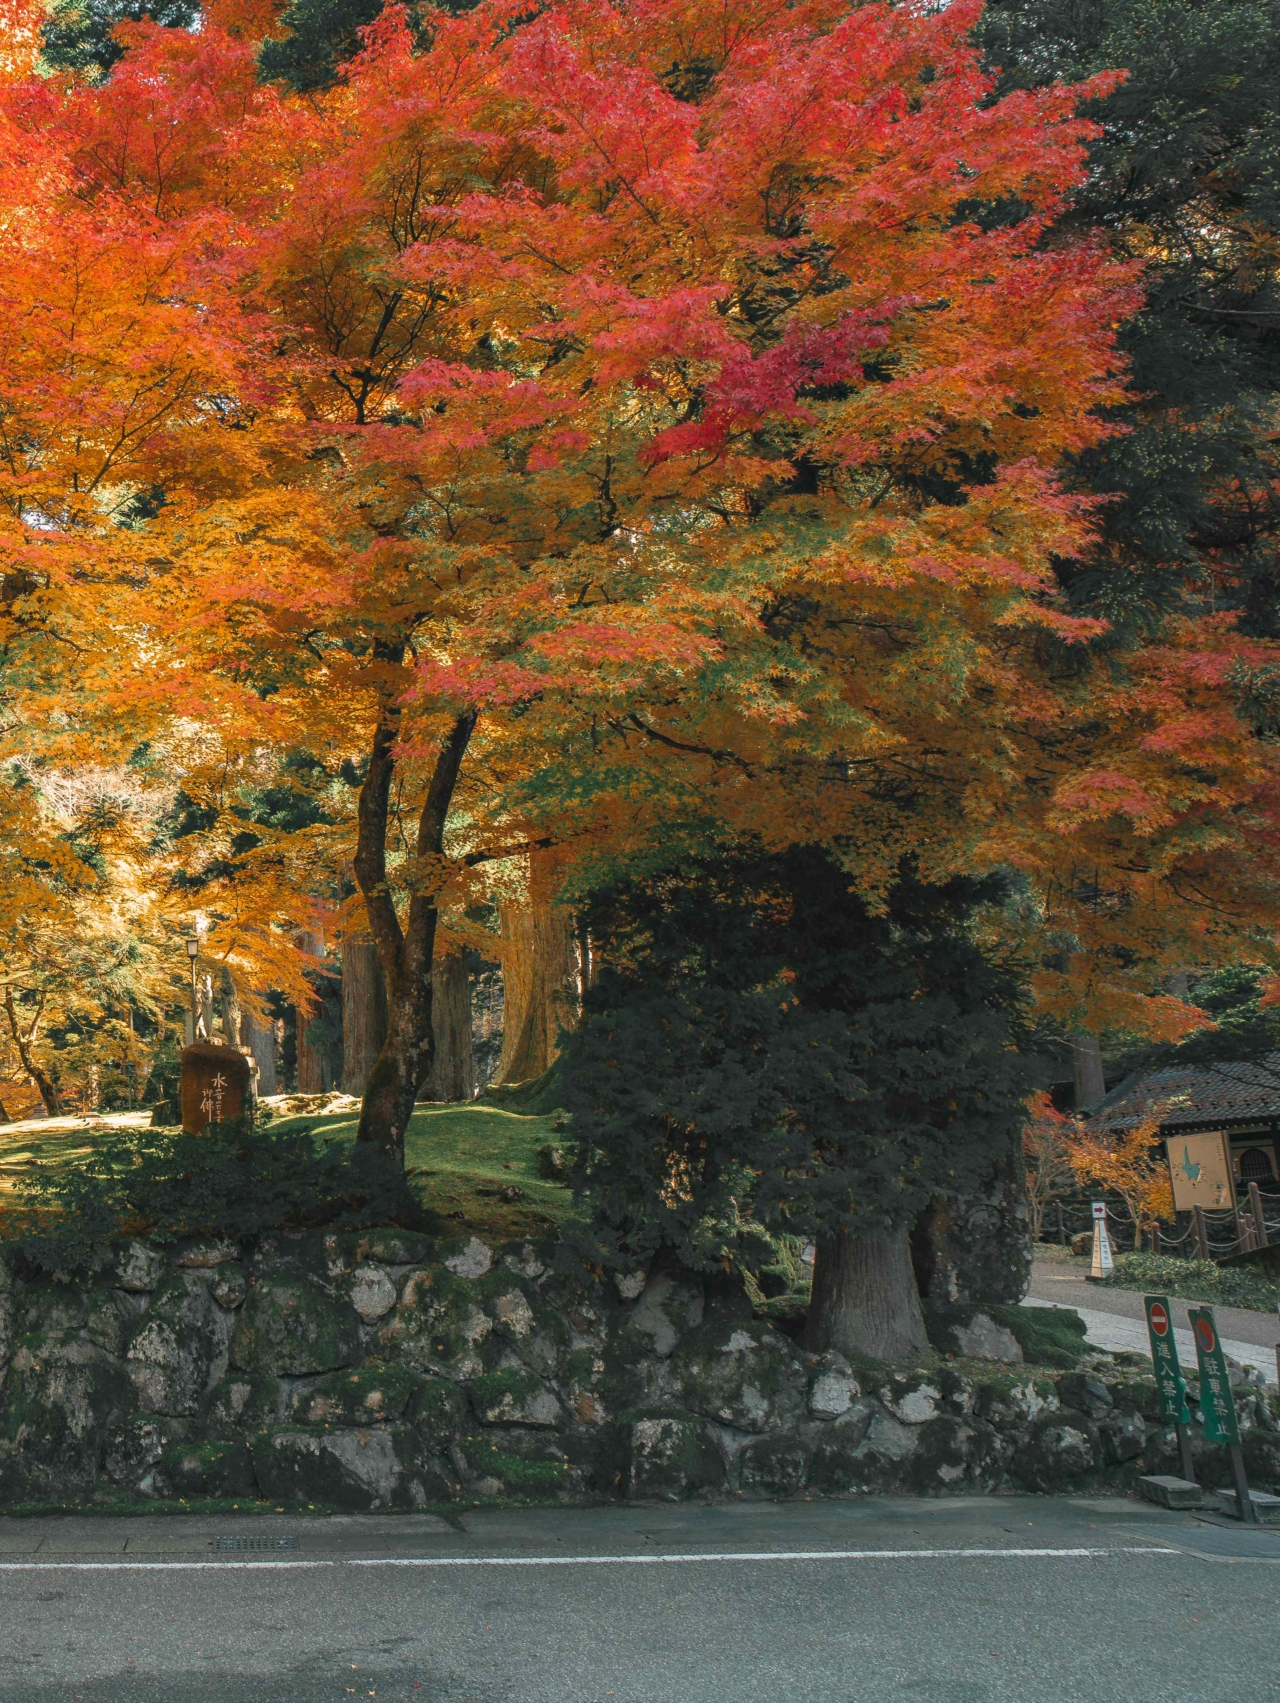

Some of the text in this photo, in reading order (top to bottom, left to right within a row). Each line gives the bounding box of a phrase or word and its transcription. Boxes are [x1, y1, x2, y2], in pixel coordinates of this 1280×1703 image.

[1156, 1341, 1179, 1416] 進入禁止
[1203, 1357, 1231, 1436] 駐車禁止
